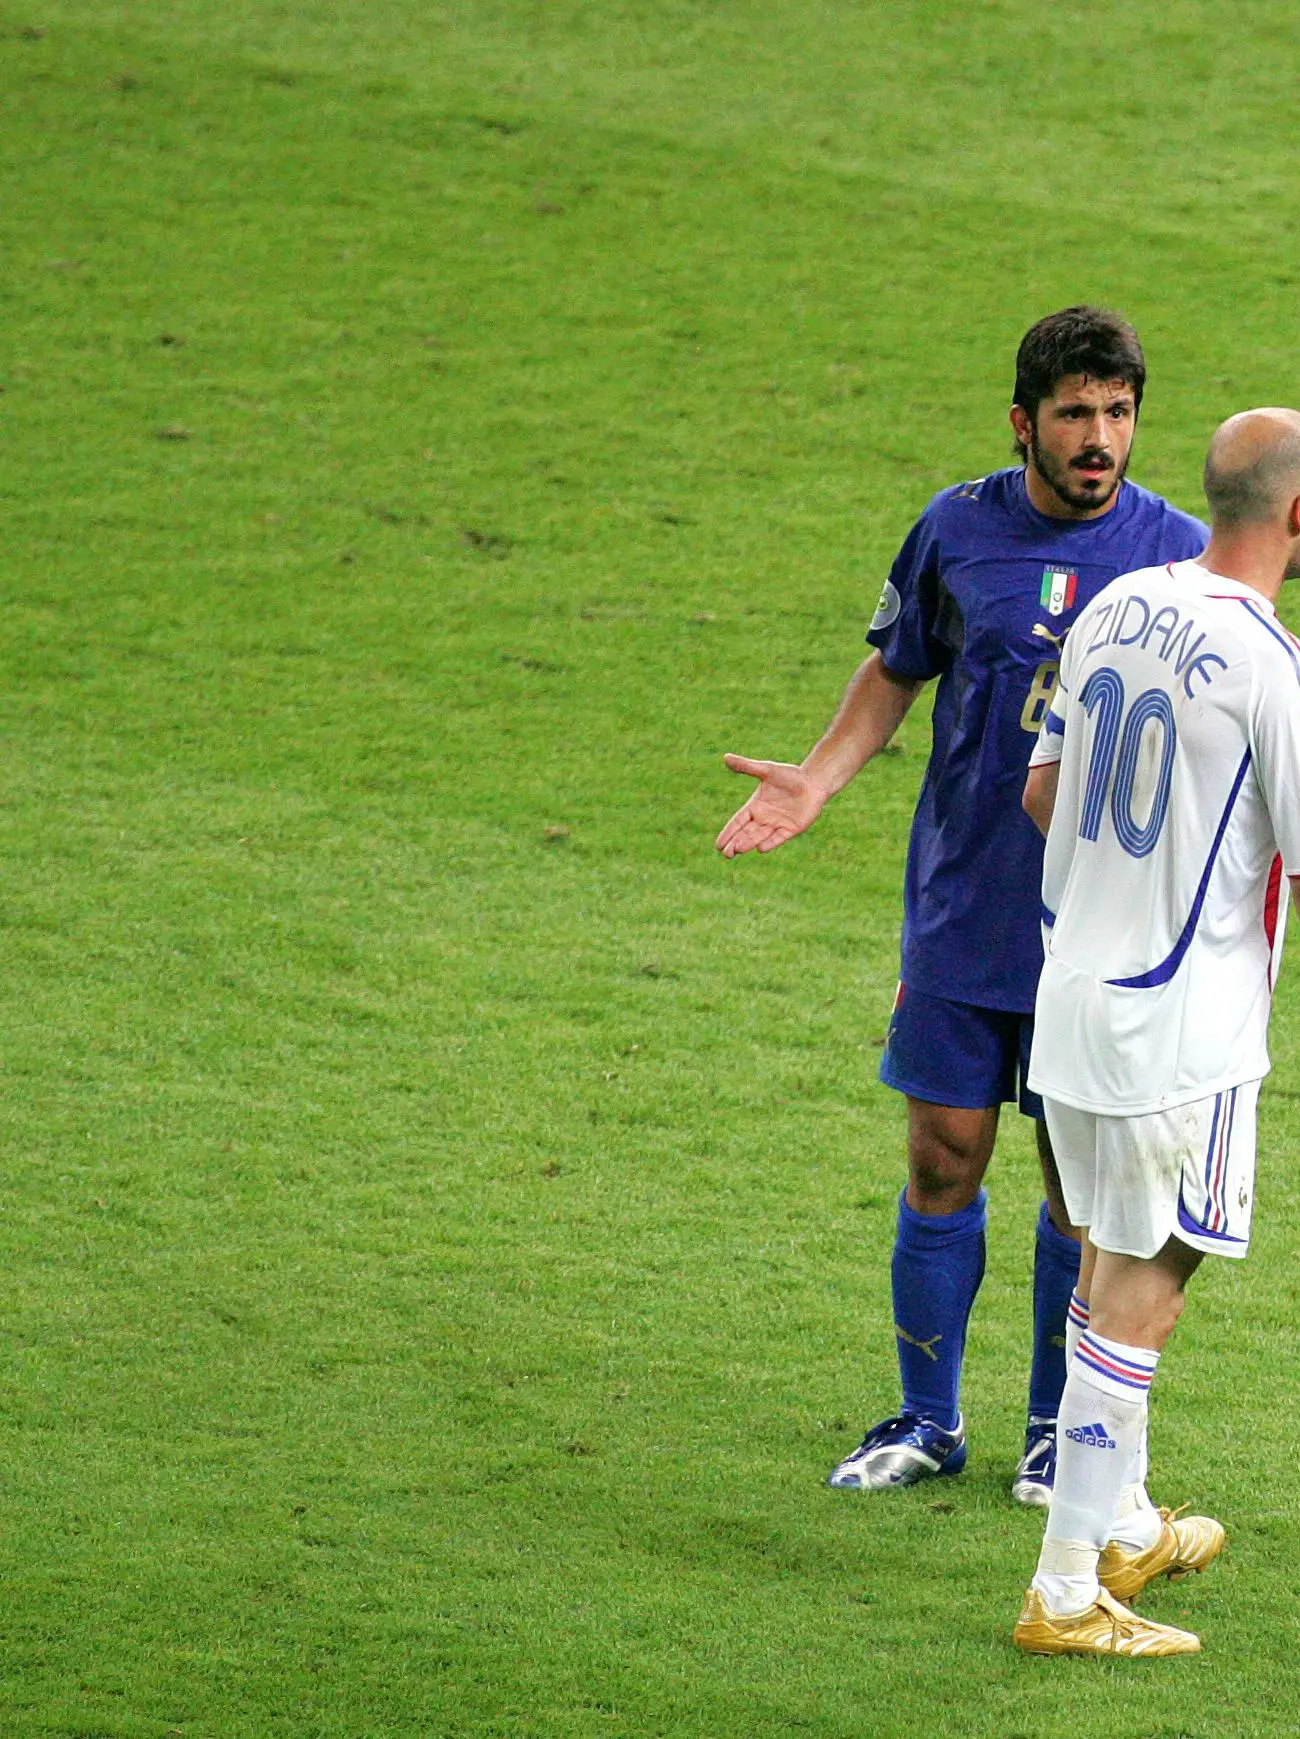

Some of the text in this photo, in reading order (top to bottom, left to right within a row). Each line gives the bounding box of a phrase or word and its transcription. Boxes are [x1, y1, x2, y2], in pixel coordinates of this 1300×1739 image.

[1085, 595, 1228, 700] ZIDANE
[1020, 661, 1060, 733] 8
[1078, 666, 1177, 859] 10
[1065, 1427, 1117, 1449] adidas
